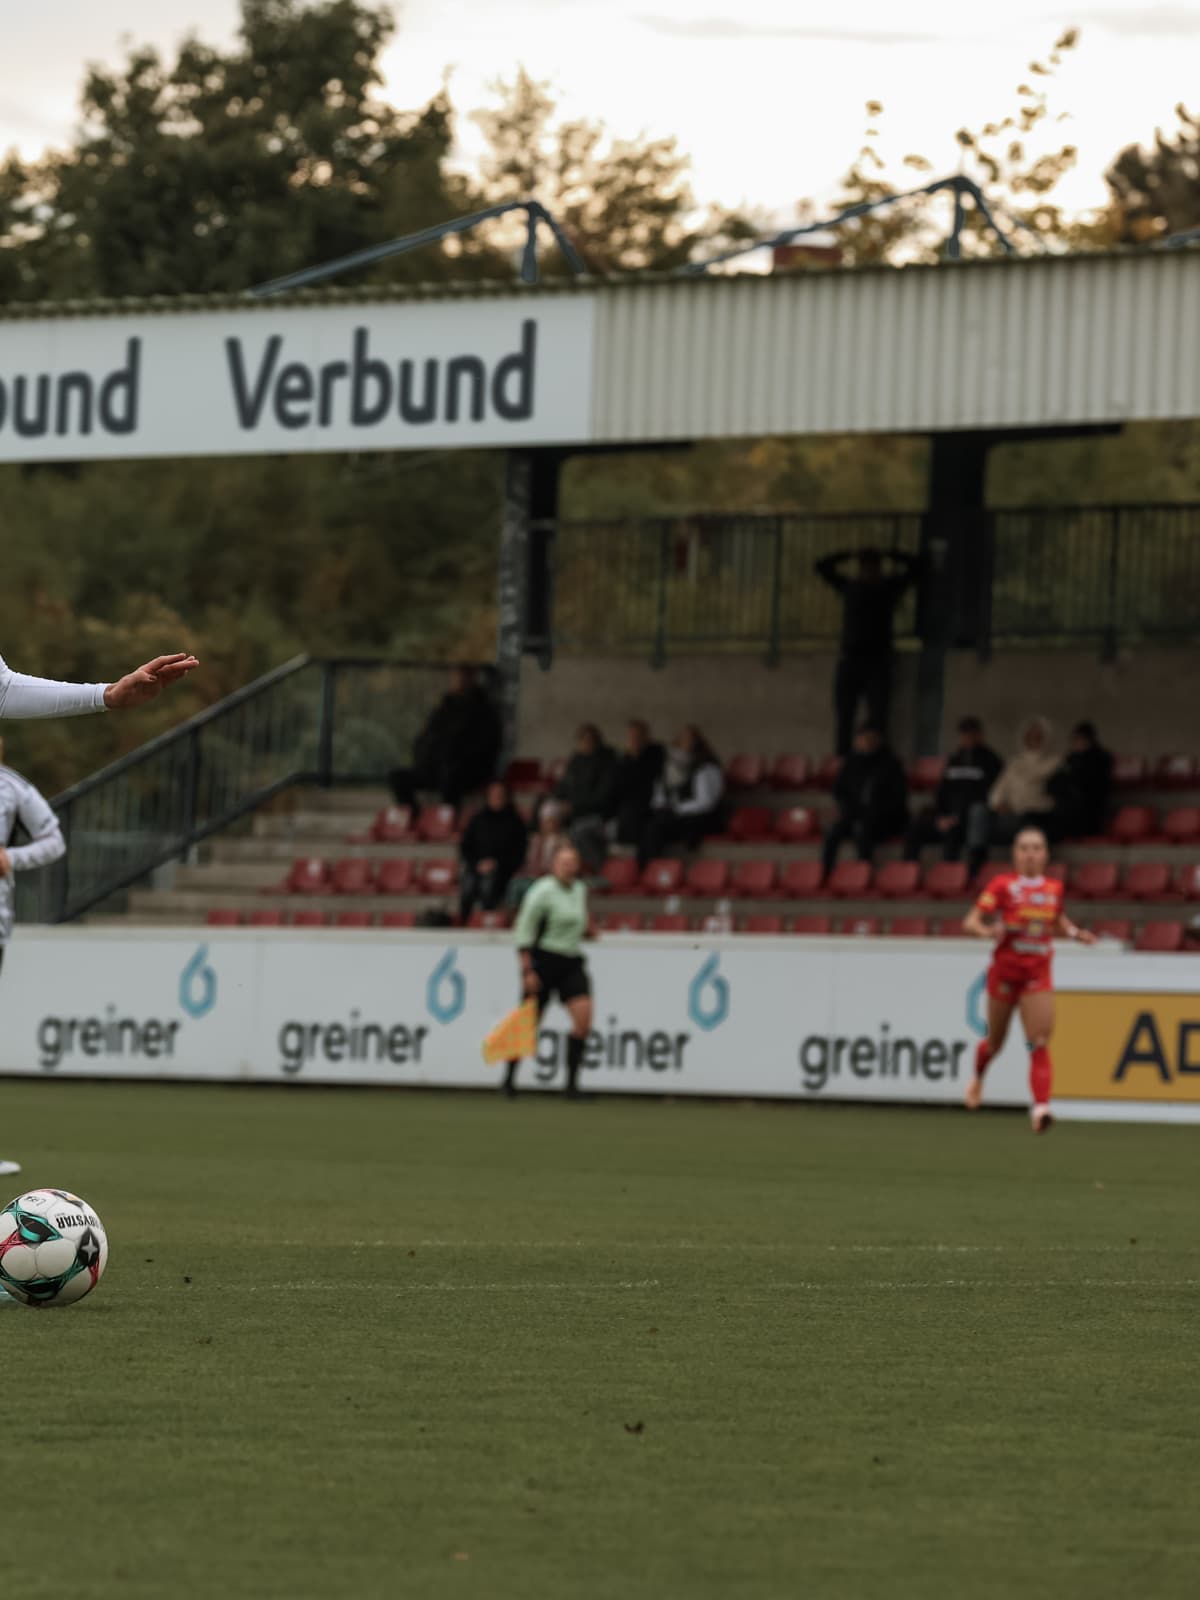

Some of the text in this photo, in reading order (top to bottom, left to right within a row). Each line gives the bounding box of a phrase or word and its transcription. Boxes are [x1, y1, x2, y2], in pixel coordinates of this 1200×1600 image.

[225, 318, 537, 431] Verbund
[38, 1002, 180, 1069] greiner
[278, 1007, 428, 1074] greiner
[534, 1014, 691, 1082] geiner
[800, 1021, 967, 1091] greiner
